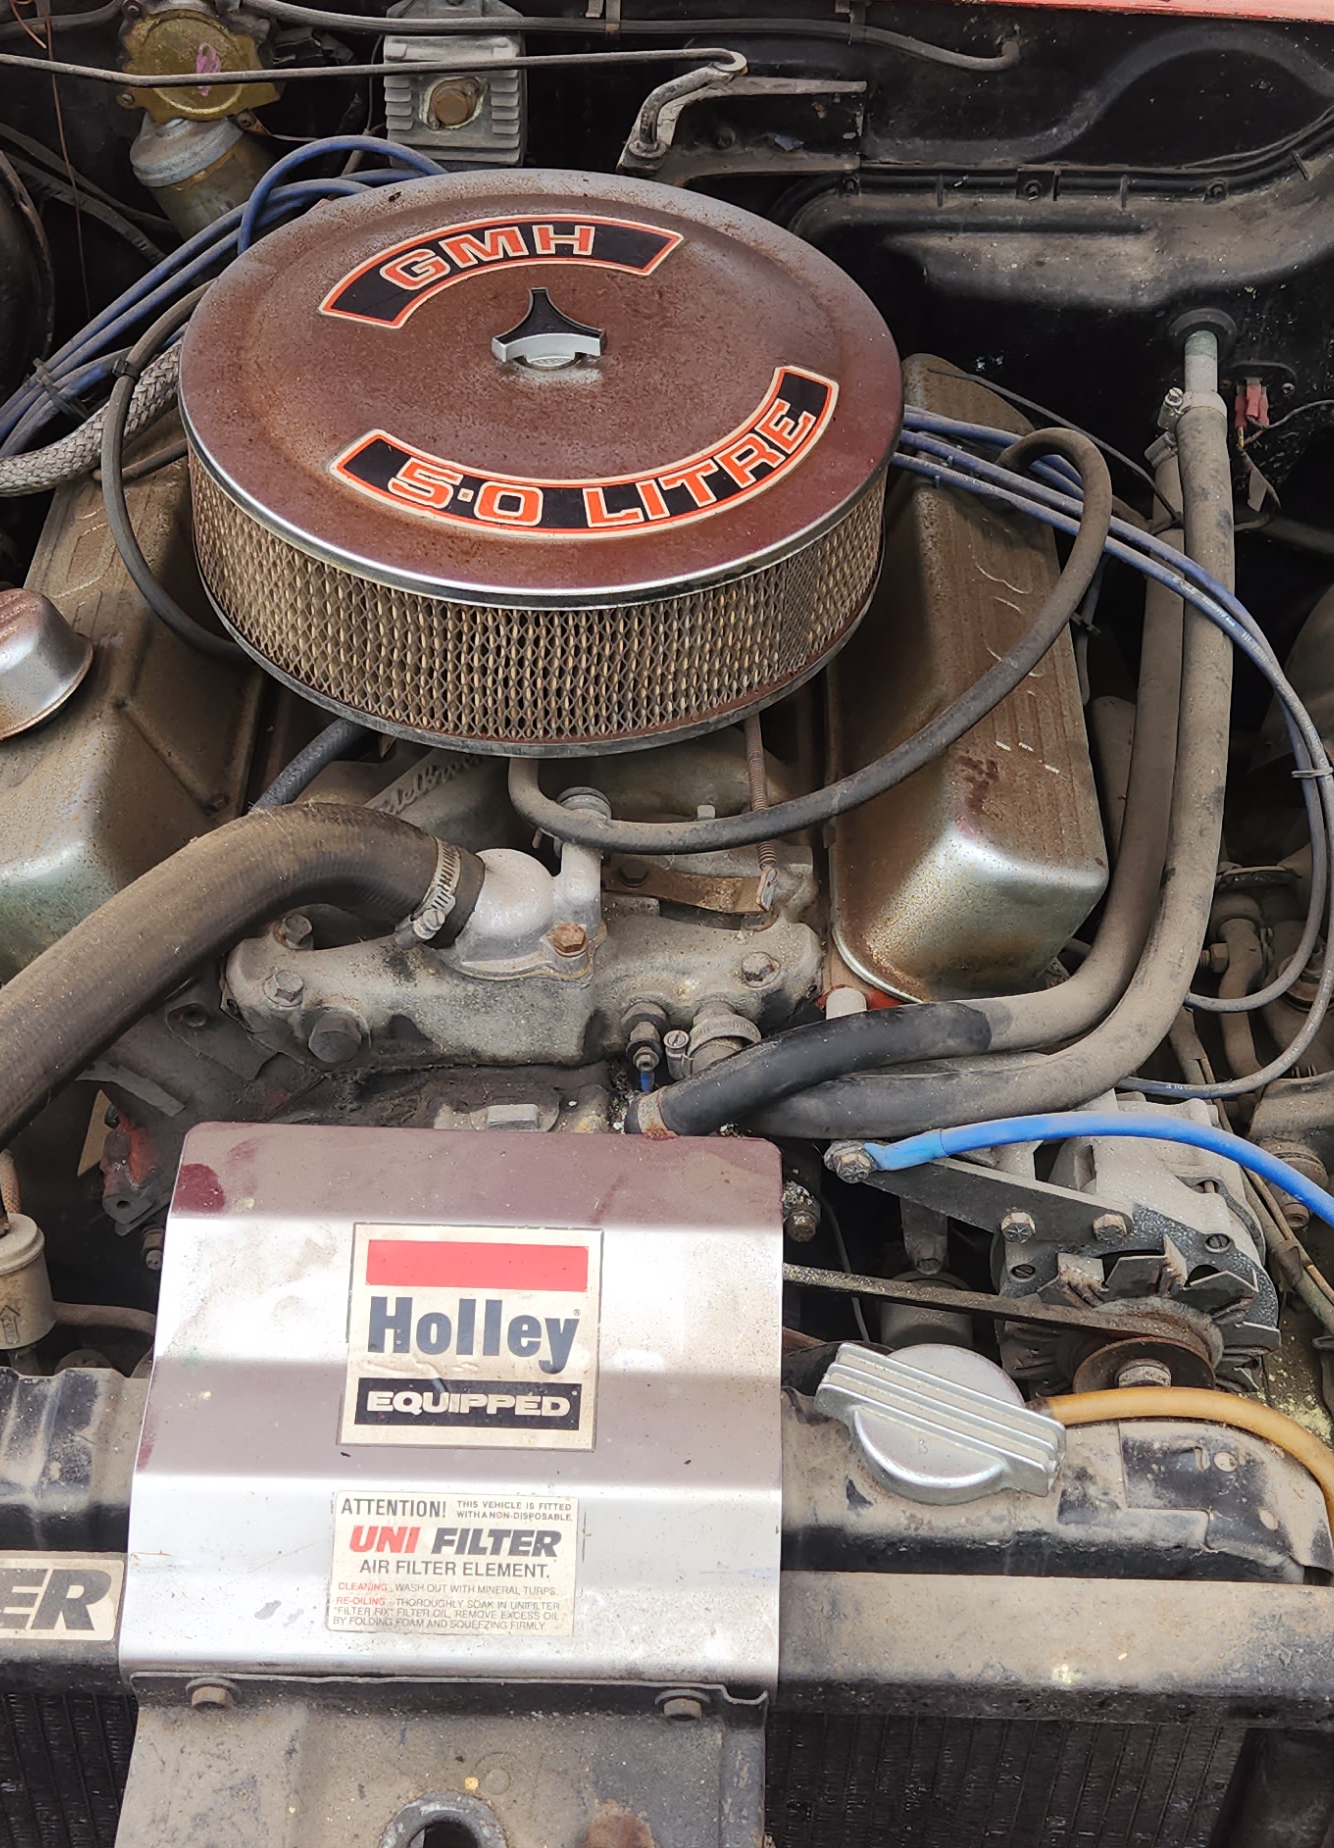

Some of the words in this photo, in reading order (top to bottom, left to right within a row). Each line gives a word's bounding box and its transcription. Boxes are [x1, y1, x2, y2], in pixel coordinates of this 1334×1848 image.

[380, 224, 595, 290] GMH
[584, 400, 817, 528] LITRE
[367, 1296, 580, 1375] Holley
[366, 1391, 571, 1417] EQUIPPED
[341, 1498, 446, 1518] ATTENTION!
[457, 1500, 478, 1508] THIS
[482, 1501, 522, 1509] VEHICLE
[527, 1502, 535, 1510] IS
[539, 1502, 571, 1511] FITTED
[349, 1525, 421, 1554] UNI
[431, 1527, 562, 1557] FILTER
[360, 1559, 390, 1575] AIR
[396, 1560, 456, 1577] FILTER
[463, 1562, 550, 1579] ELEMENT.
[395, 1583, 424, 1592] WASH
[427, 1584, 447, 1592] OUT
[450, 1585, 475, 1593] WITH
[478, 1586, 520, 1595] MINERAL
[396, 1598, 464, 1608] THOROUGHLY
[467, 1600, 493, 1609] SOAK
[498, 1601, 507, 1609] IN
[510, 1601, 560, 1610] UNIFILTER
[397, 1608, 430, 1617] FILTER
[455, 1610, 497, 1619] REMOVE
[501, 1610, 540, 1619] EXCESS
[332, 1616, 347, 1625] BY
[349, 1617, 393, 1626] FOLDING
[396, 1618, 424, 1627] FOAM
[427, 1619, 447, 1628] AND
[450, 1620, 507, 1629] SQUEEZING
[511, 1621, 545, 1630] FIRMLY
